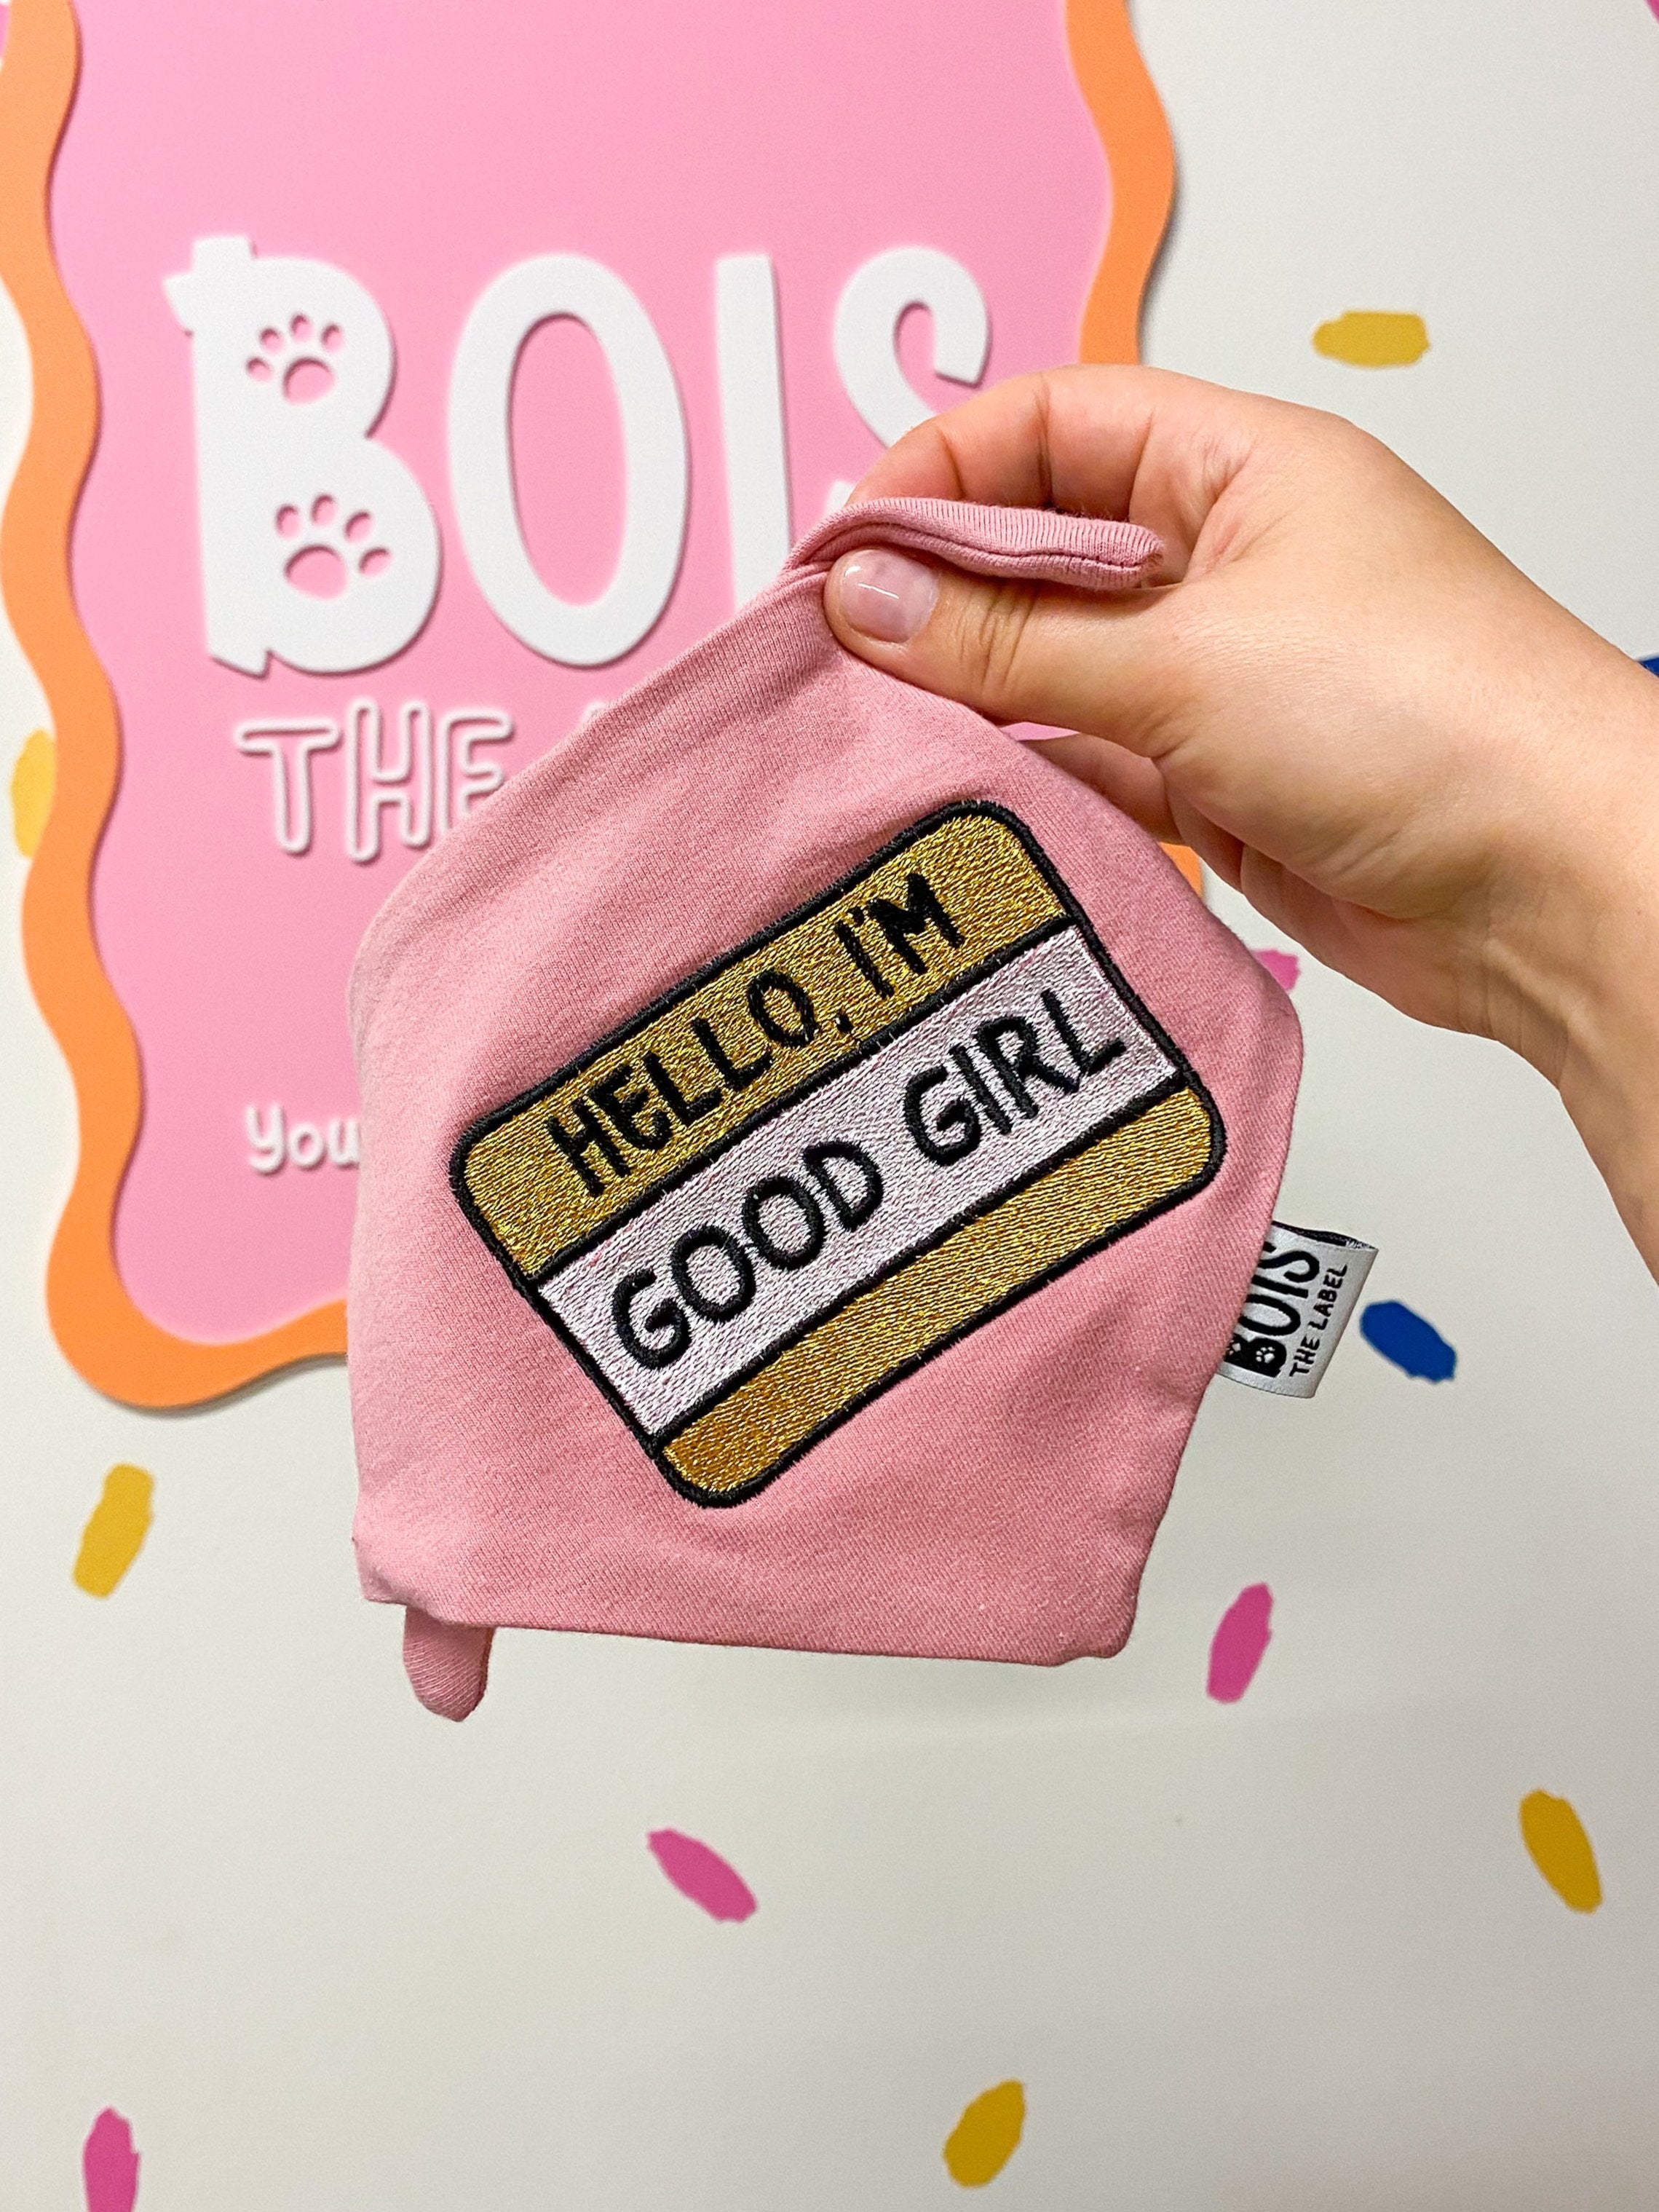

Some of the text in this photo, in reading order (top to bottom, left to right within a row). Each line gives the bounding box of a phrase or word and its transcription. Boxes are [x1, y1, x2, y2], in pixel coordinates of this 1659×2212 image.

[234, 696, 513, 865] THE
[545, 873, 967, 1196] HELLO, I'M
[609, 989, 1128, 1370] GOOD GIRL
[1224, 1241, 1321, 1378] BOIS
[1288, 1263, 1347, 1378] THE LABEL
